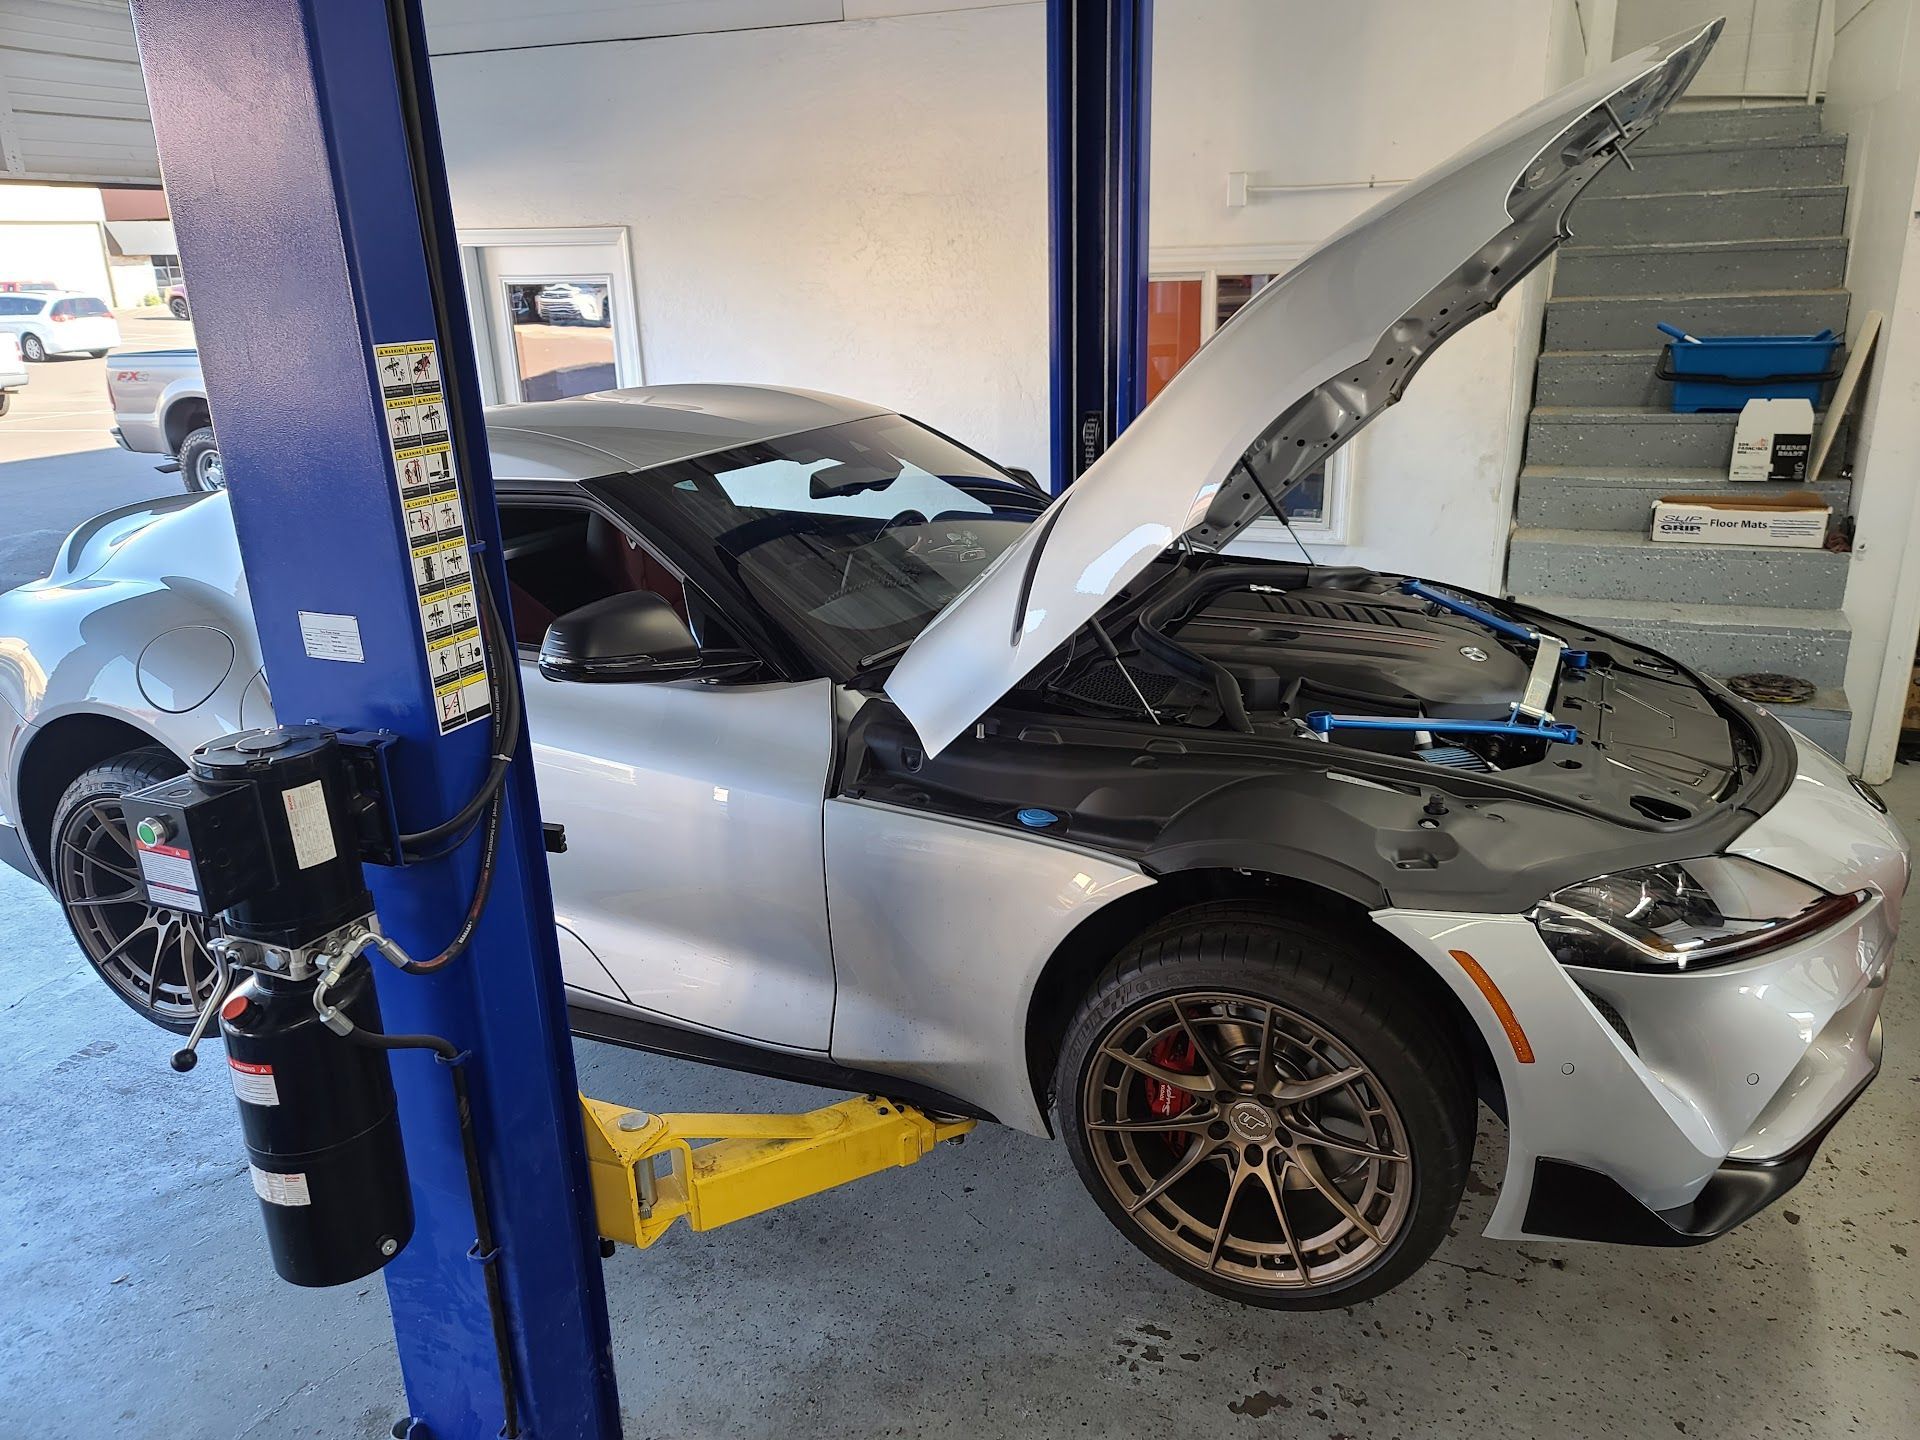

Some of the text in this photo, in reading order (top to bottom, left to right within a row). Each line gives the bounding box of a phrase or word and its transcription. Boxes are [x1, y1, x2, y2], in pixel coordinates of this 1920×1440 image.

[403, 449, 422, 457] WARNING
[430, 445, 449, 454] WARNING
[438, 493, 457, 501] CAUTION
[411, 499, 431, 507] CAUTION
[1710, 519, 1739, 528] Floor
[1741, 521, 1768, 529] Mats
[446, 540, 464, 548] CAUTION
[419, 546, 438, 555] CAUTION
[454, 585, 471, 594] CAUTION
[427, 593, 446, 602] CAUTION
